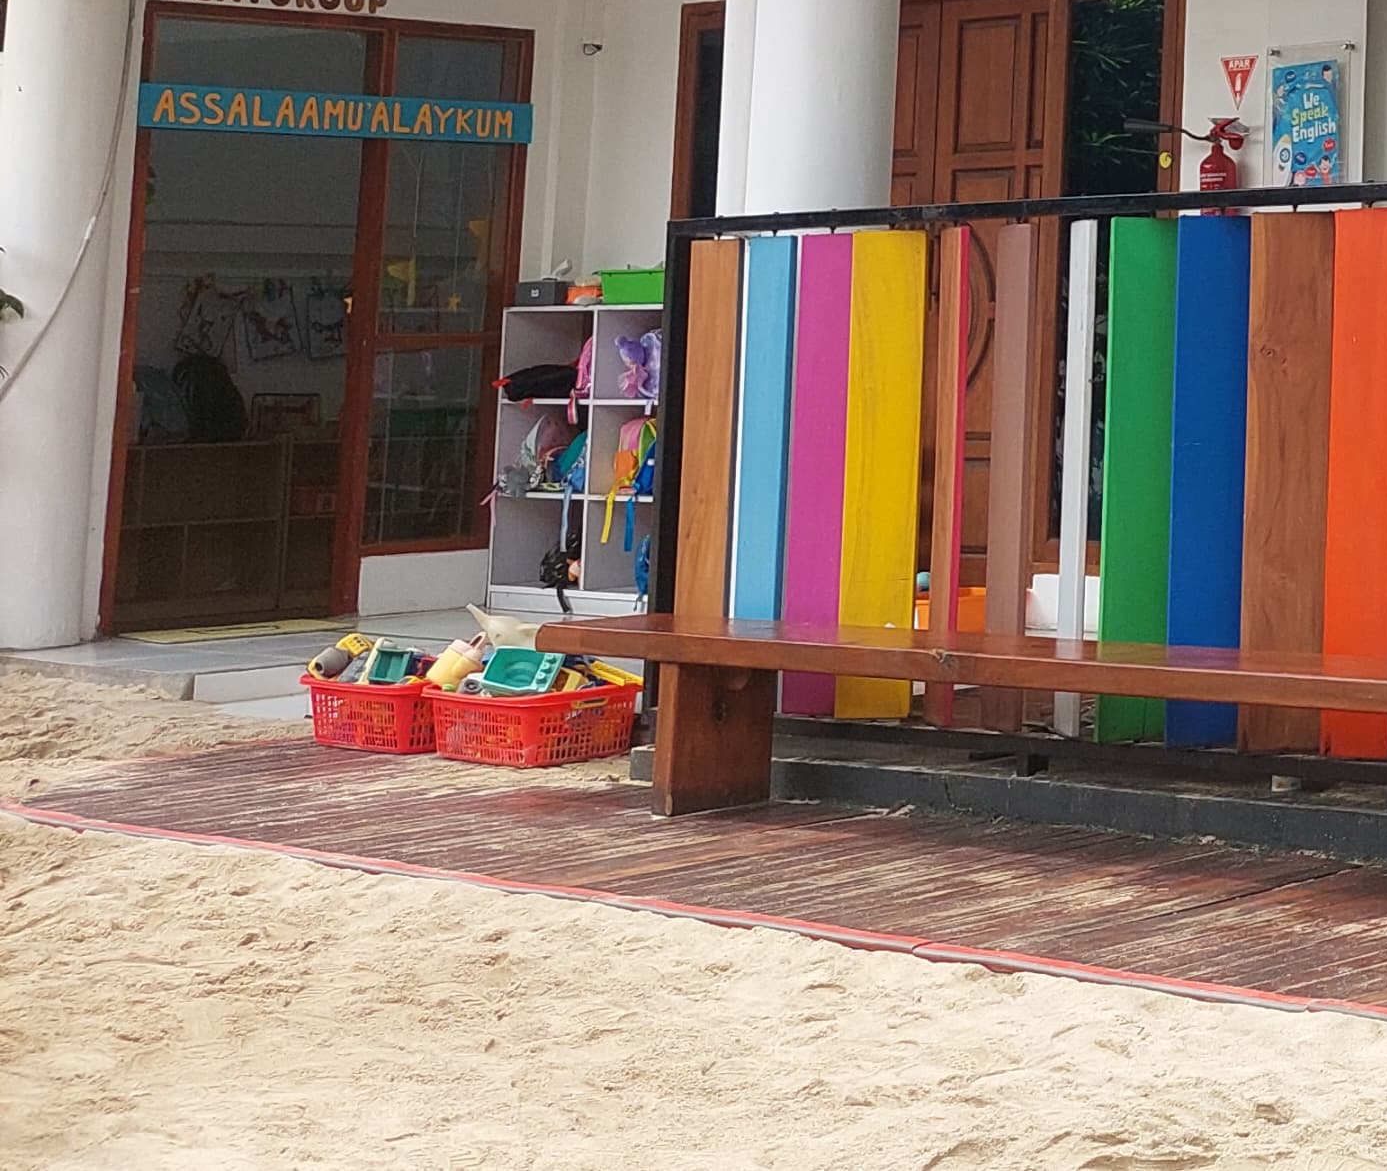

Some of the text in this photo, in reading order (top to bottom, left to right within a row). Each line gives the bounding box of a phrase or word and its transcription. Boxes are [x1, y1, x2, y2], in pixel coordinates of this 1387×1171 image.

[1228, 59, 1251, 69] APAR
[1302, 92, 1320, 110] We
[151, 88, 515, 140] ASSALAAMU'ALAYKUM
[1291, 104, 1329, 127] Speak
[1292, 118, 1337, 143] English
